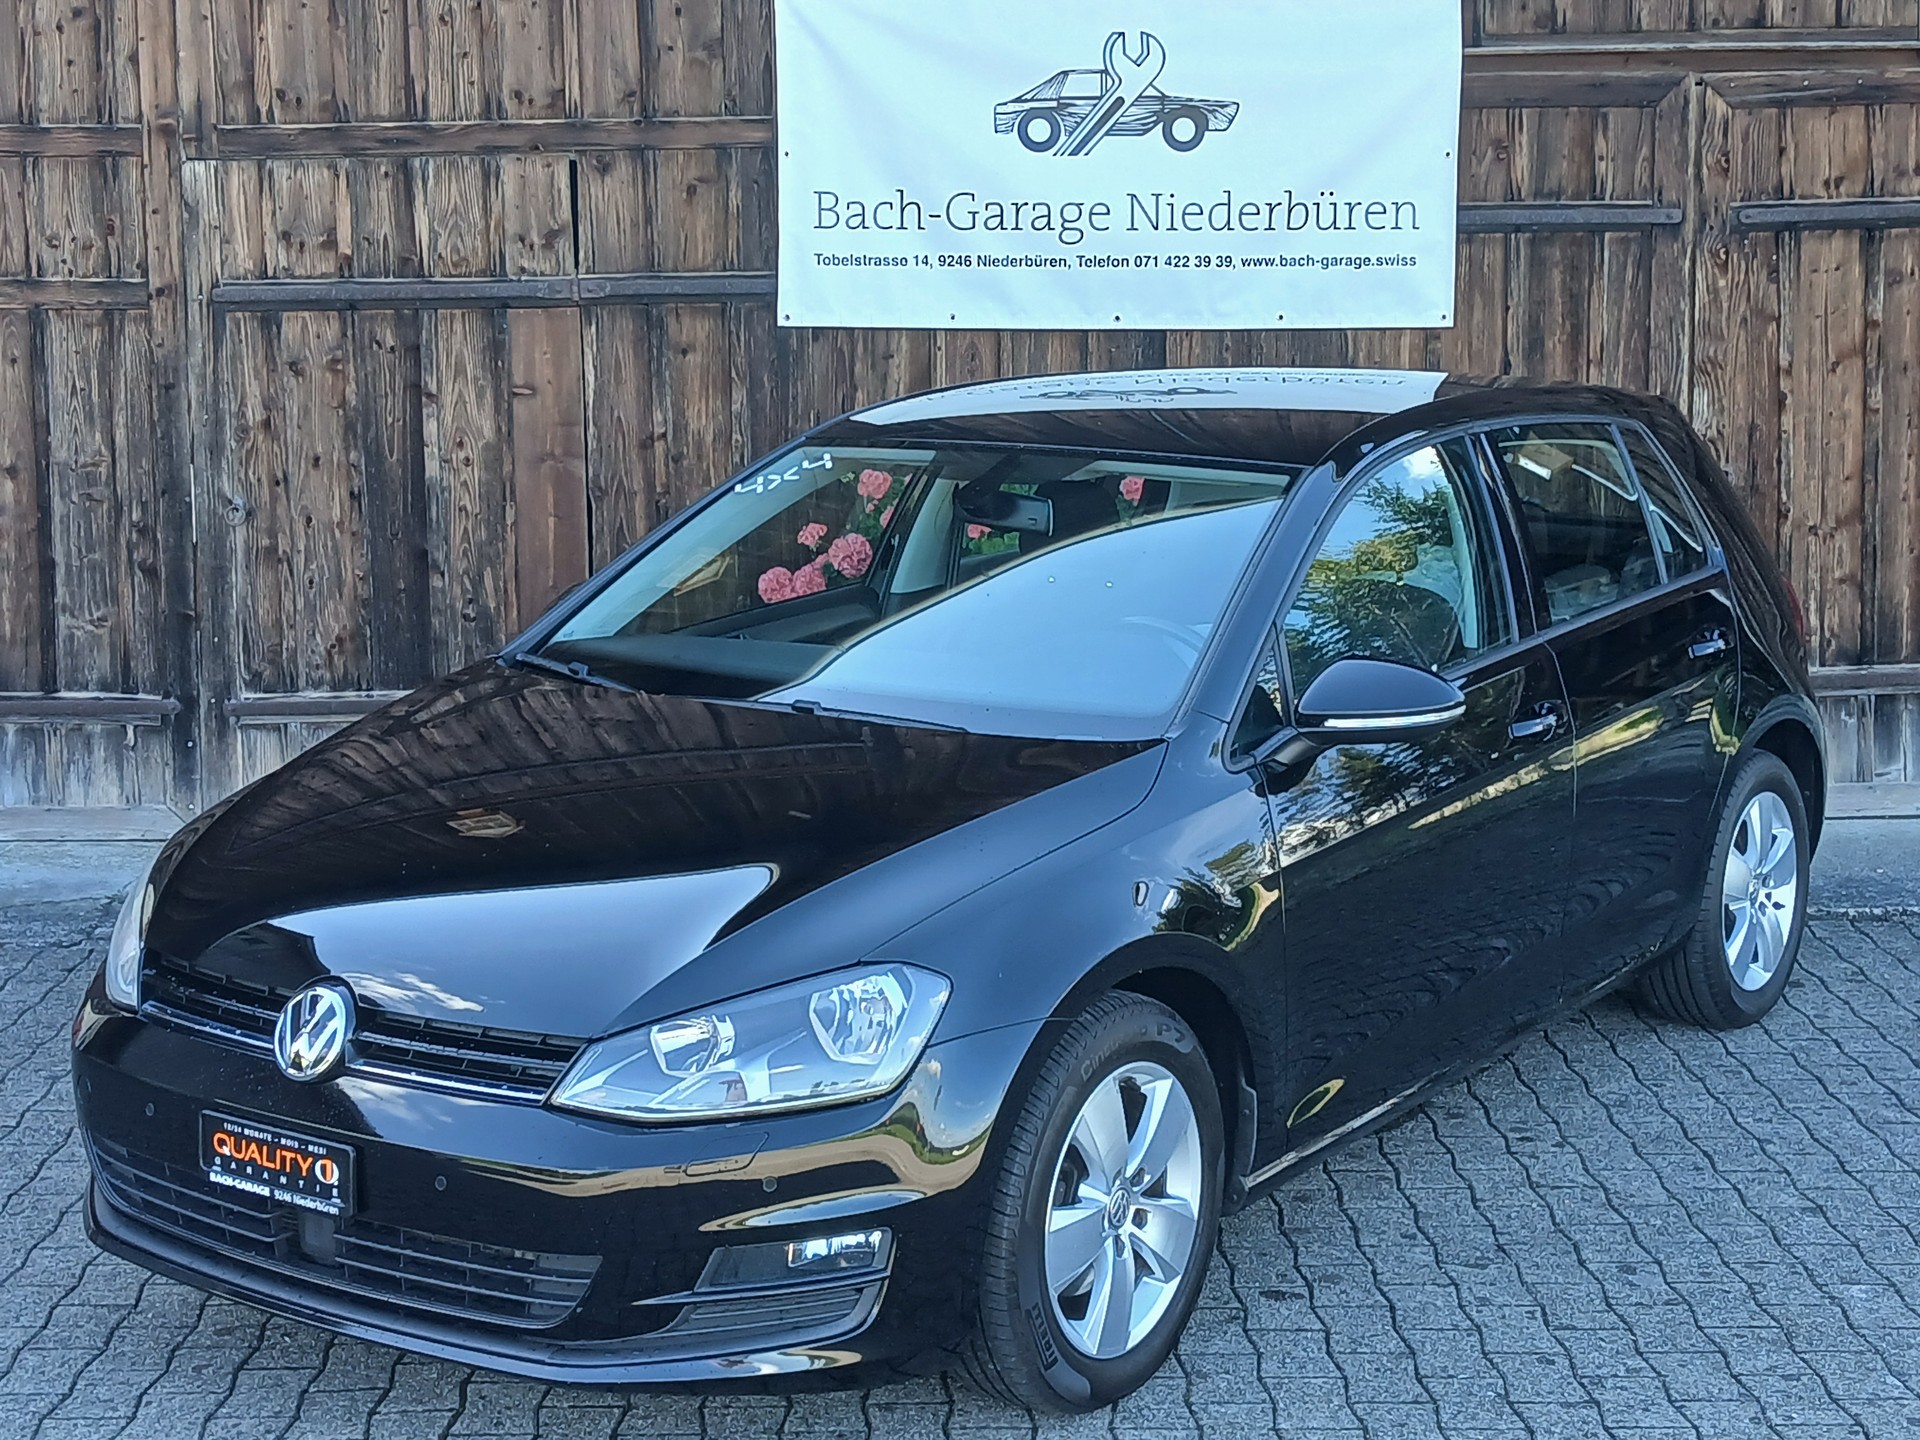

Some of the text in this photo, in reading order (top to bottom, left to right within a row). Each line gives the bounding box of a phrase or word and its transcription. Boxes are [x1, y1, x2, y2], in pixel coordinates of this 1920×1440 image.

[813, 189, 1420, 245] Bach-Garage Niederbüren
[814, 253, 1416, 270] Tobelstrasse 14, 9246 Niederbüren, Telefon 071 422 39 39, www.bach-garage.swiss
[213, 1131, 314, 1177] QUALITY
